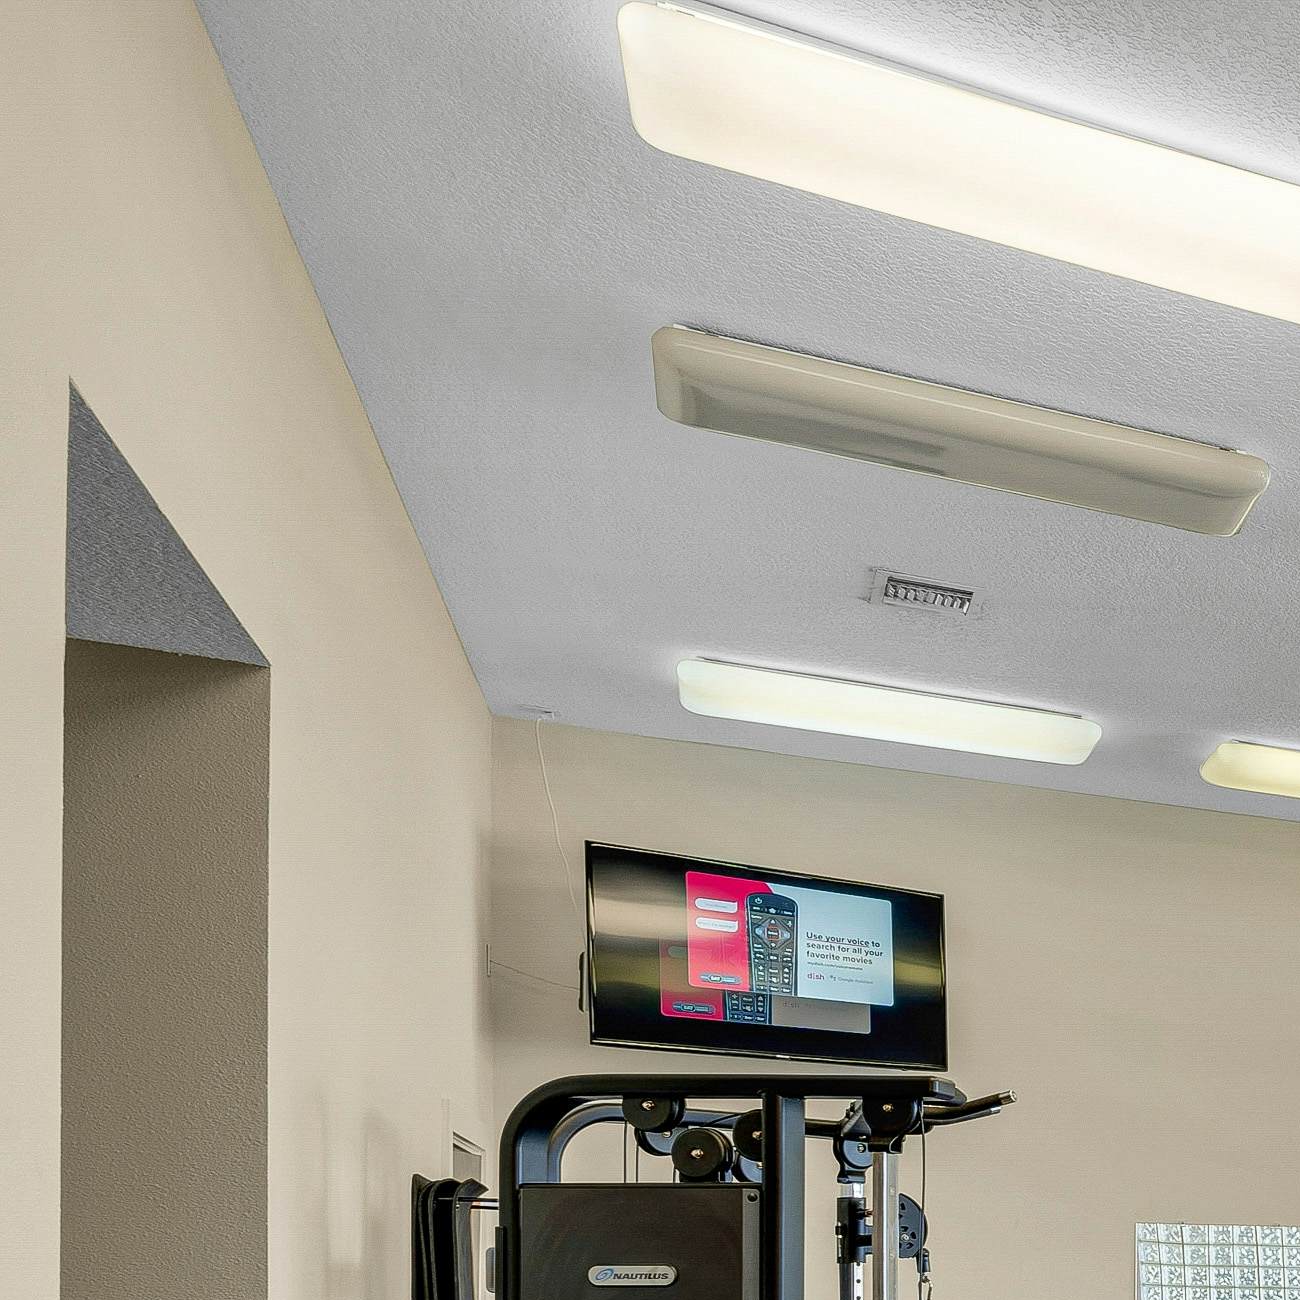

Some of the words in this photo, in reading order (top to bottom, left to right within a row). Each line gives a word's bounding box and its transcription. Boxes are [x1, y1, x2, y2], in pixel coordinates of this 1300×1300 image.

[807, 942, 835, 951] search
[847, 938, 869, 946] voice
[807, 951, 840, 960] favorite
[843, 956, 872, 964] movies
